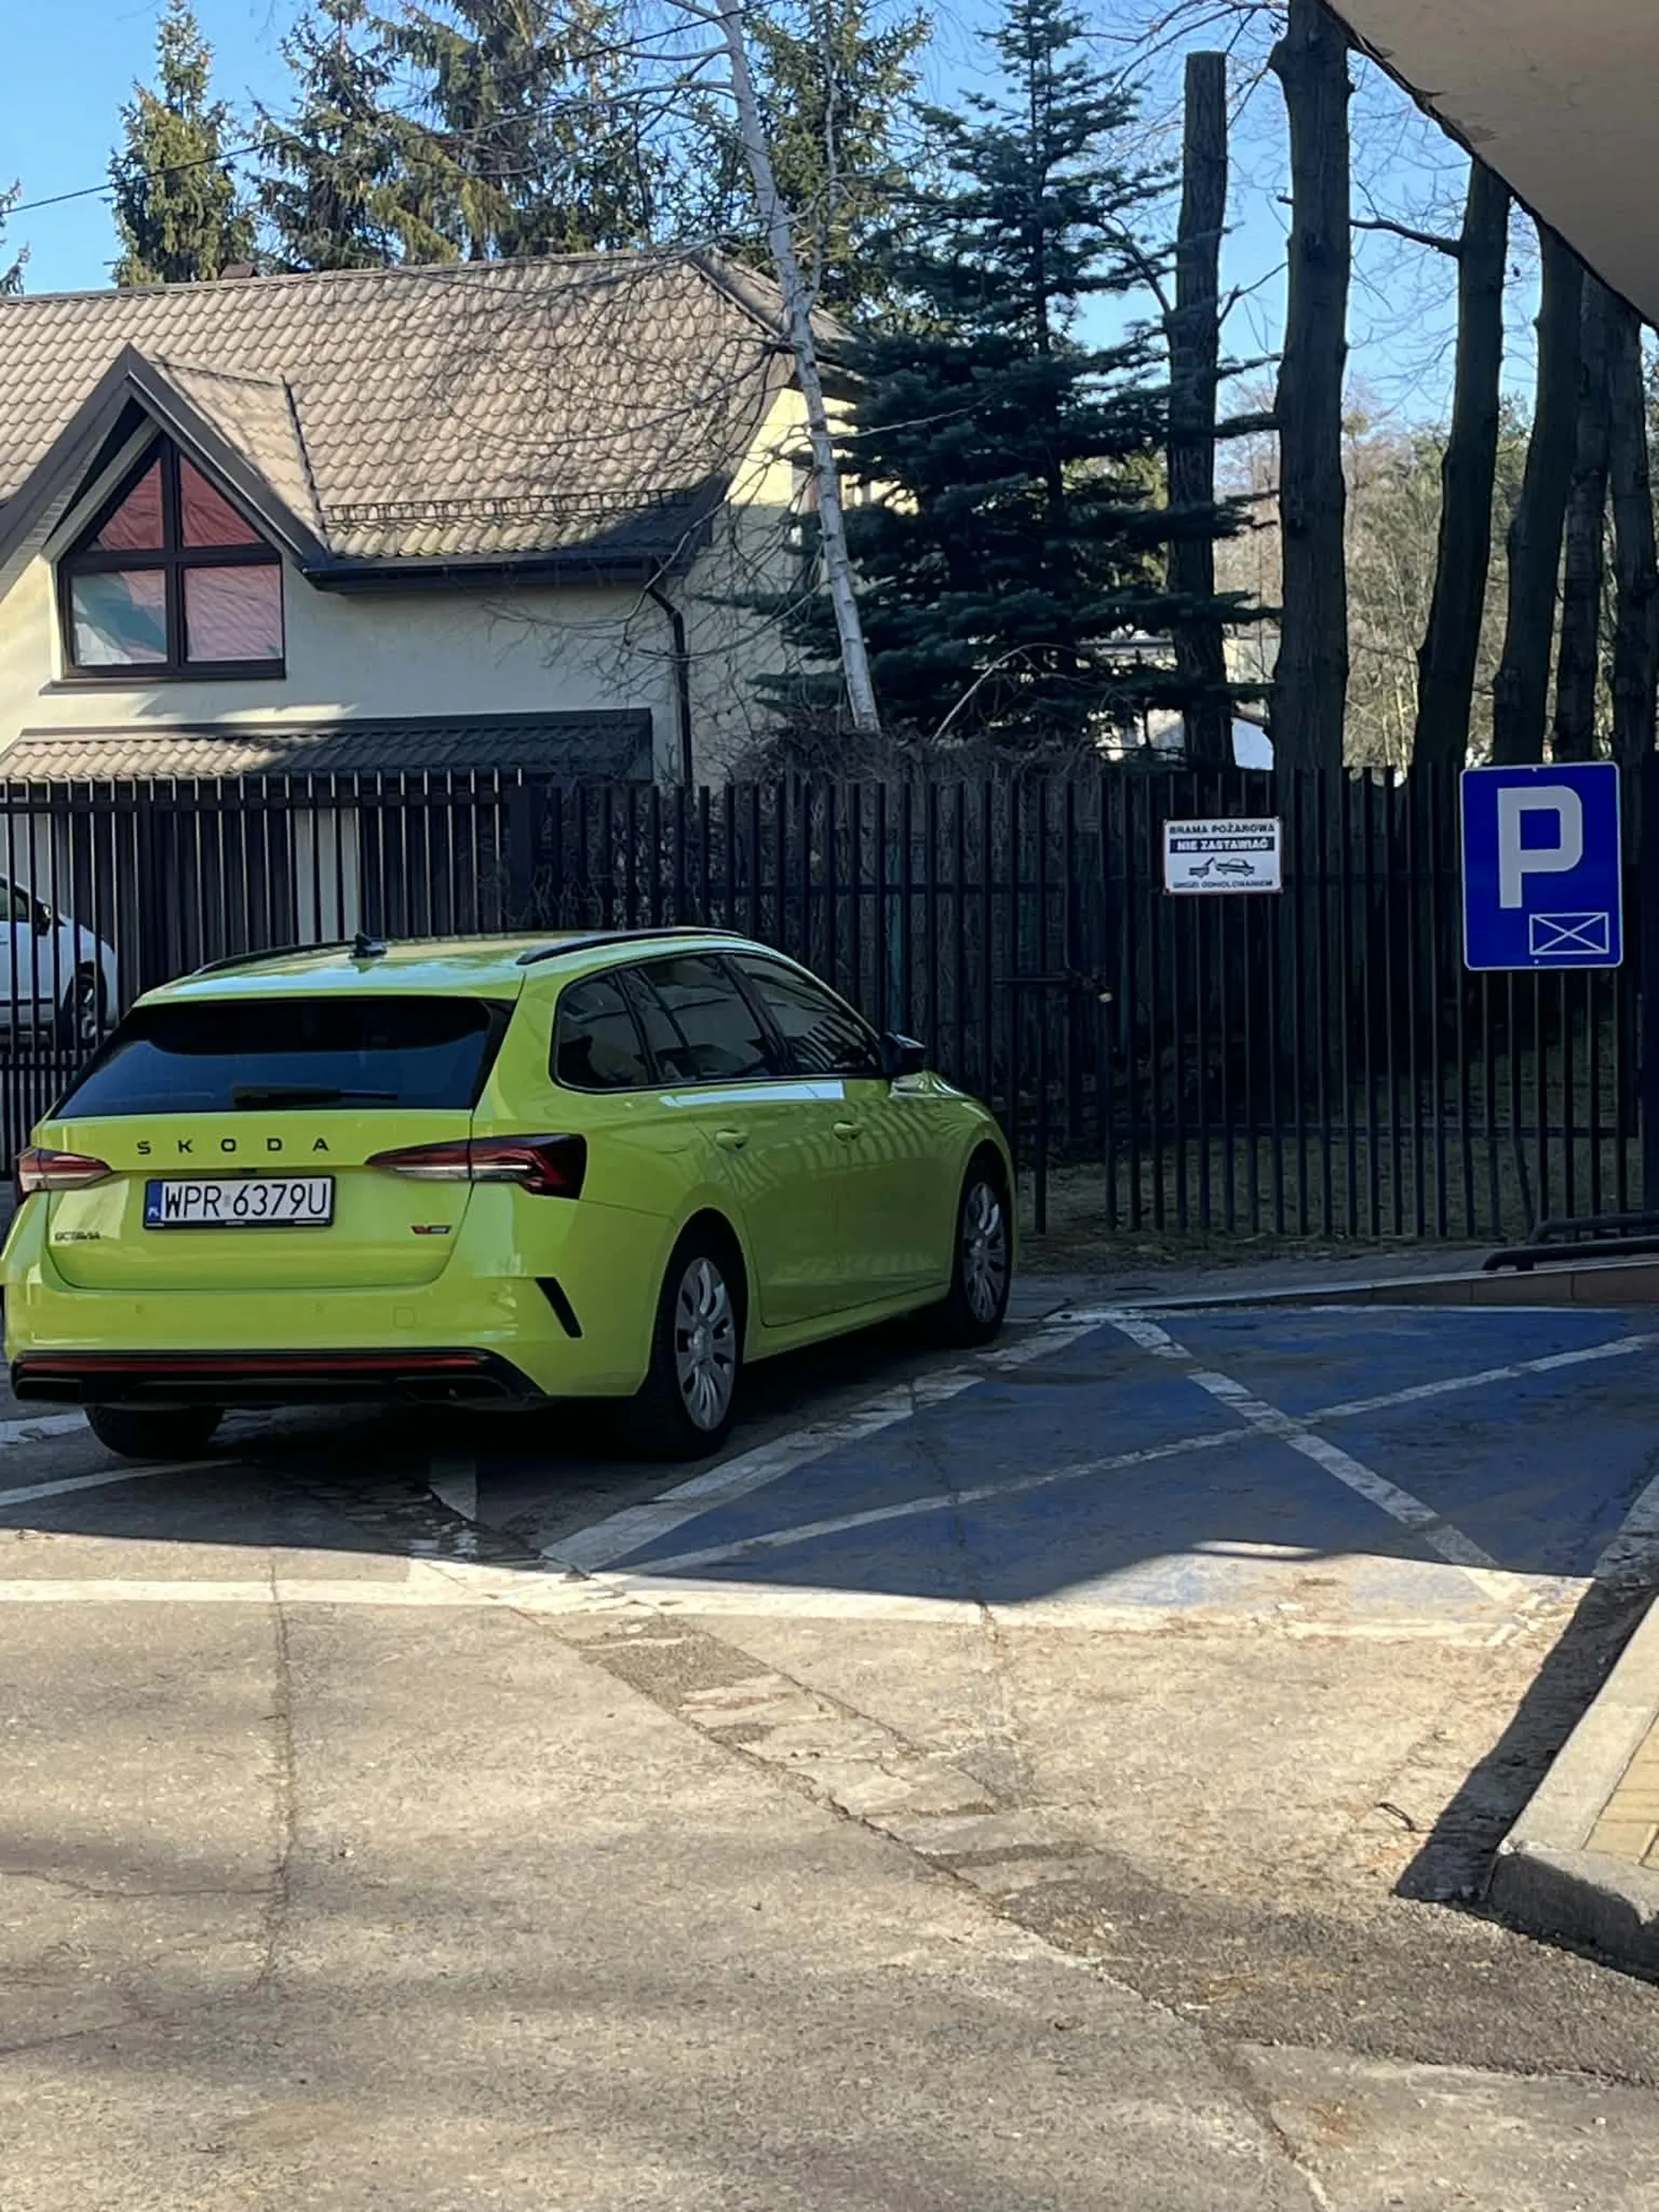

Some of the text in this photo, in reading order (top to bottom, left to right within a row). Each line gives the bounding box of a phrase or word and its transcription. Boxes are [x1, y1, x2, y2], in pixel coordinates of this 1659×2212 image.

[1170, 822, 1275, 834] BRAMA POŻAROWA
[1177, 838, 1268, 850] NIE ZASTAWIAĆ
[1497, 785, 1583, 909] P
[165, 1183, 326, 1218] WPR 6379U
